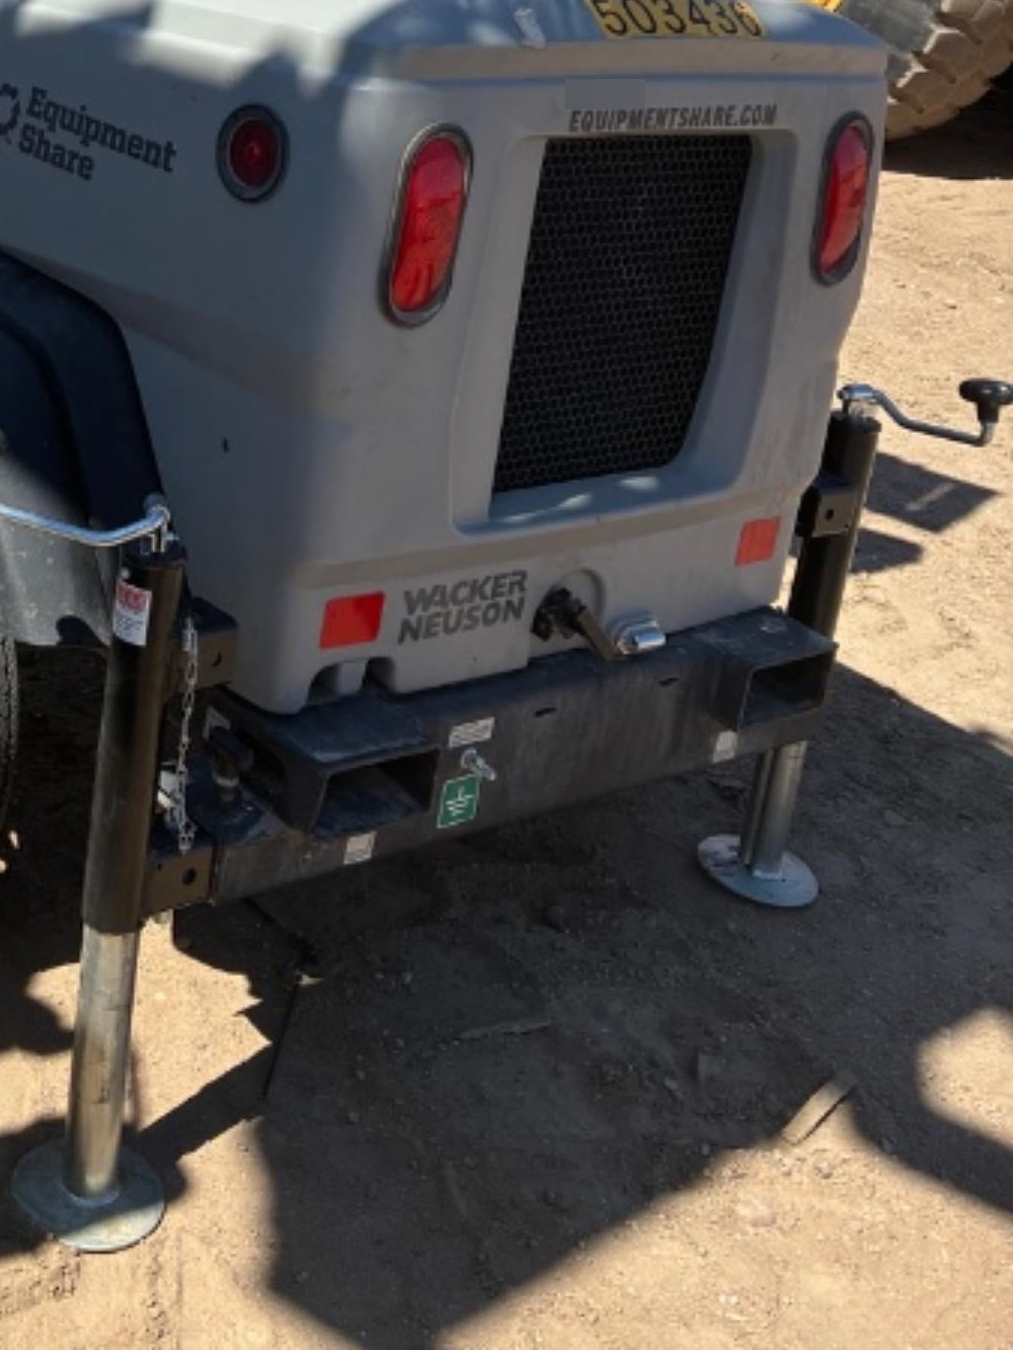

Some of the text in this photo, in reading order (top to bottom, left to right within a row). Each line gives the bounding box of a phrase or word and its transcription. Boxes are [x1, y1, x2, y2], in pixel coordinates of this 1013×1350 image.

[28, 85, 177, 173] Equipment
[569, 104, 778, 131] EQUIPMENTSHARE.COM
[19, 127, 95, 181] Share
[404, 570, 527, 616] WACKER
[398, 596, 525, 645] NEUSON
